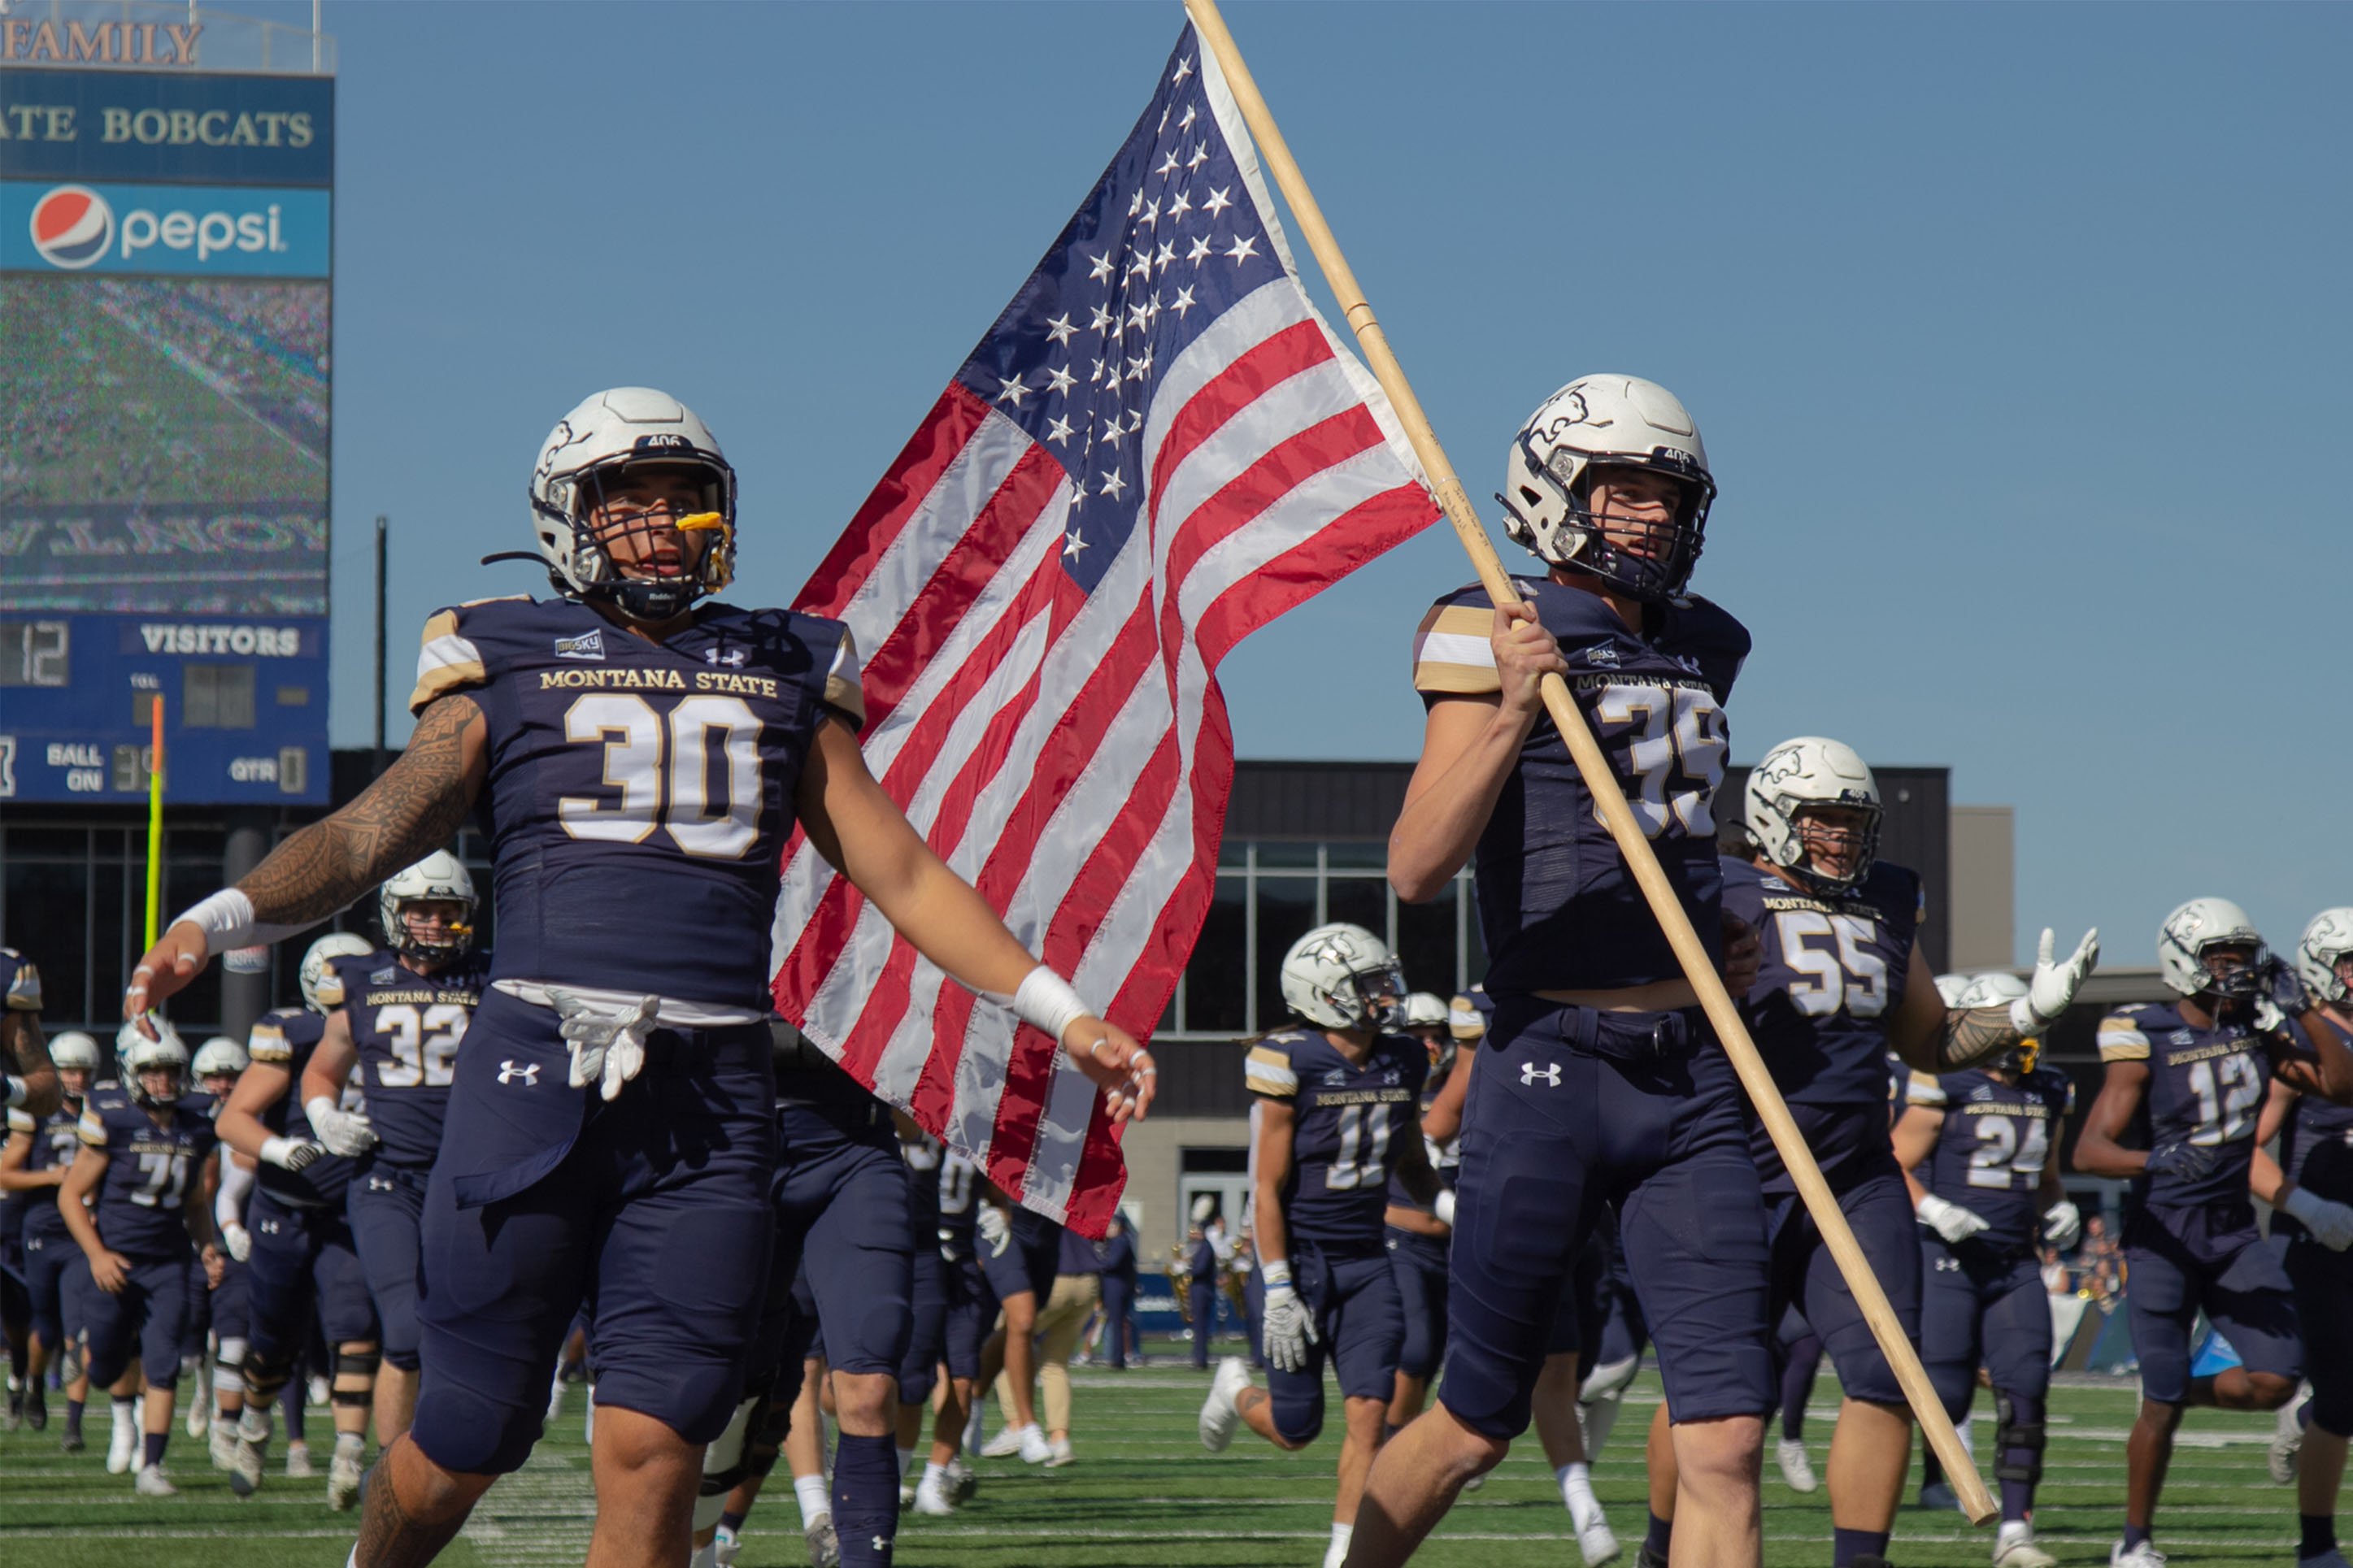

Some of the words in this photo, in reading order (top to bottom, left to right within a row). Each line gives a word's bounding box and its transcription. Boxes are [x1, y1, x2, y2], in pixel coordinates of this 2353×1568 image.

[2, 17, 204, 65] FAMILY
[101, 106, 315, 148] BOBCATS
[120, 204, 281, 262] pepsi
[140, 623, 300, 657] VISITORS
[540, 668, 685, 689] MONTANA
[696, 672, 777, 698] STATE
[1576, 673, 1672, 692] MONTANA
[46, 742, 104, 767] BALL
[228, 757, 278, 782] QTR
[67, 768, 103, 792] ON
[558, 693, 764, 860] 30
[1762, 897, 1838, 914] MONTANA
[1773, 909, 1888, 1018] 55
[366, 989, 433, 1006] MONTANA
[437, 990, 480, 1006] STATE
[375, 1003, 471, 1088] 32
[1316, 1089, 1378, 1106] MONTANA
[2187, 1051, 2262, 1147] 12
[1324, 1104, 1392, 1190] 11
[1967, 1114, 2049, 1190] 24
[131, 1153, 188, 1210] 71
